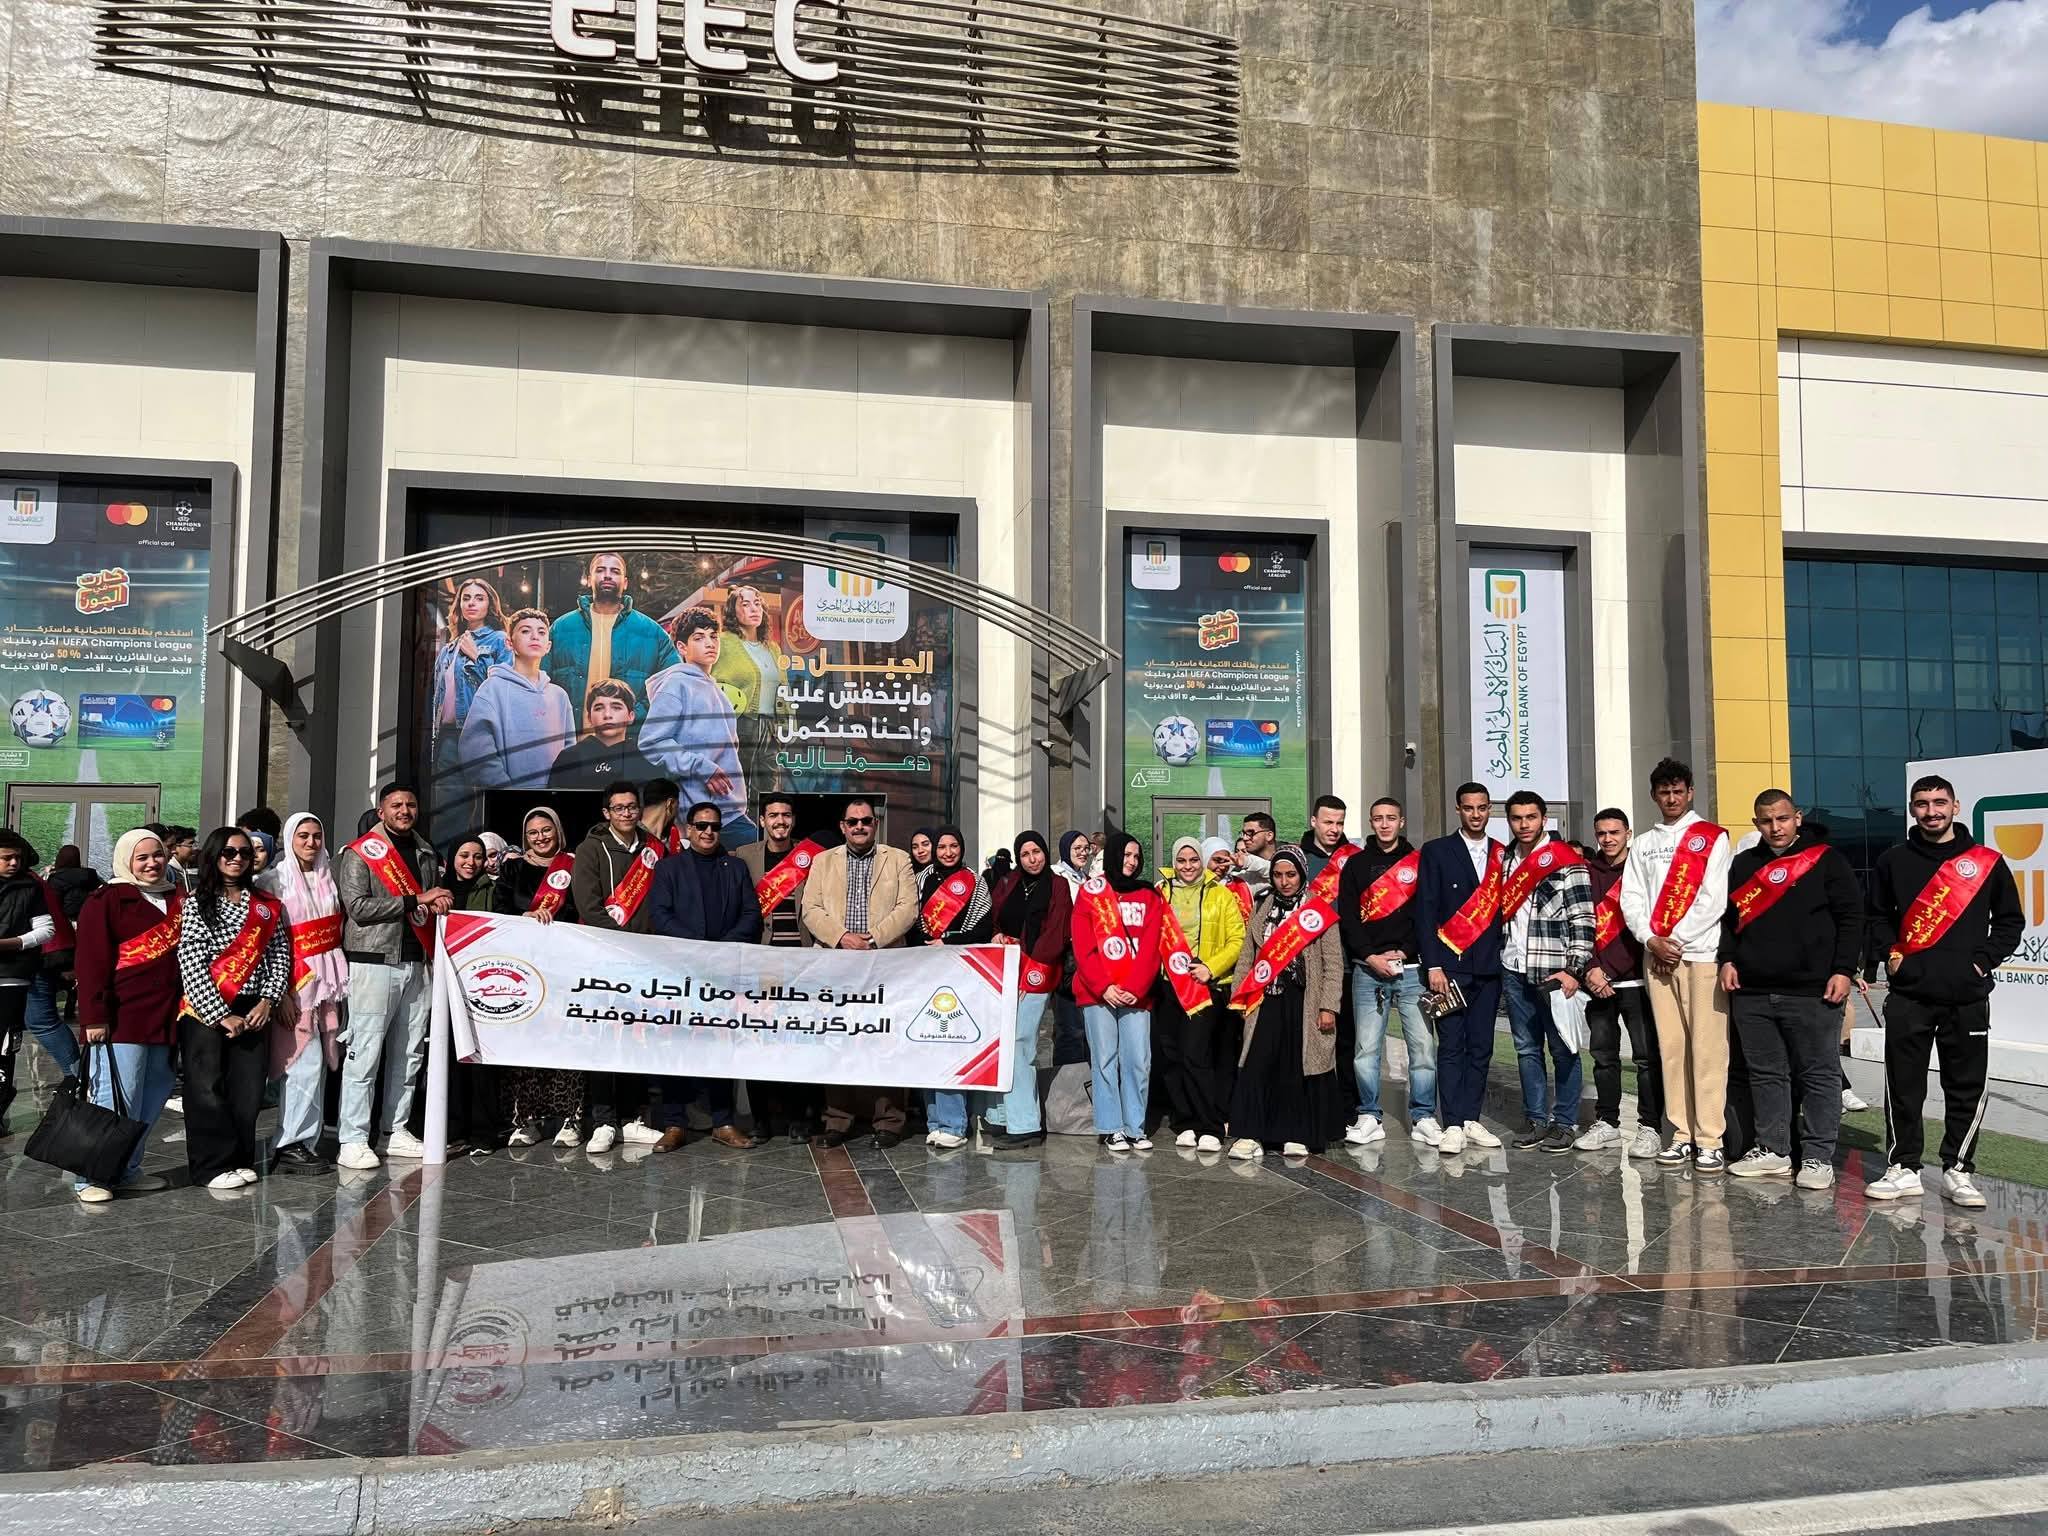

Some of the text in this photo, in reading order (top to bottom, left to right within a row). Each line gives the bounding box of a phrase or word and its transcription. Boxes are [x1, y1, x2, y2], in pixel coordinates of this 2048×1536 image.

[63, 638, 193, 651] UEFA Champions League
[153, 654, 169, 663] من
[1190, 671, 1290, 682] UEFA Champions League
[777, 680, 825, 710] عليه
[1517, 624, 1530, 779] NATIONAL BANK OF EGYPT
[777, 715, 868, 744] هنكمل
[571, 976, 885, 1007] أسرة طلاب من أجل مصر
[2006, 972, 2035, 985] BANK
[566, 1002, 891, 1036] المركزية بجامعة المنوفية
